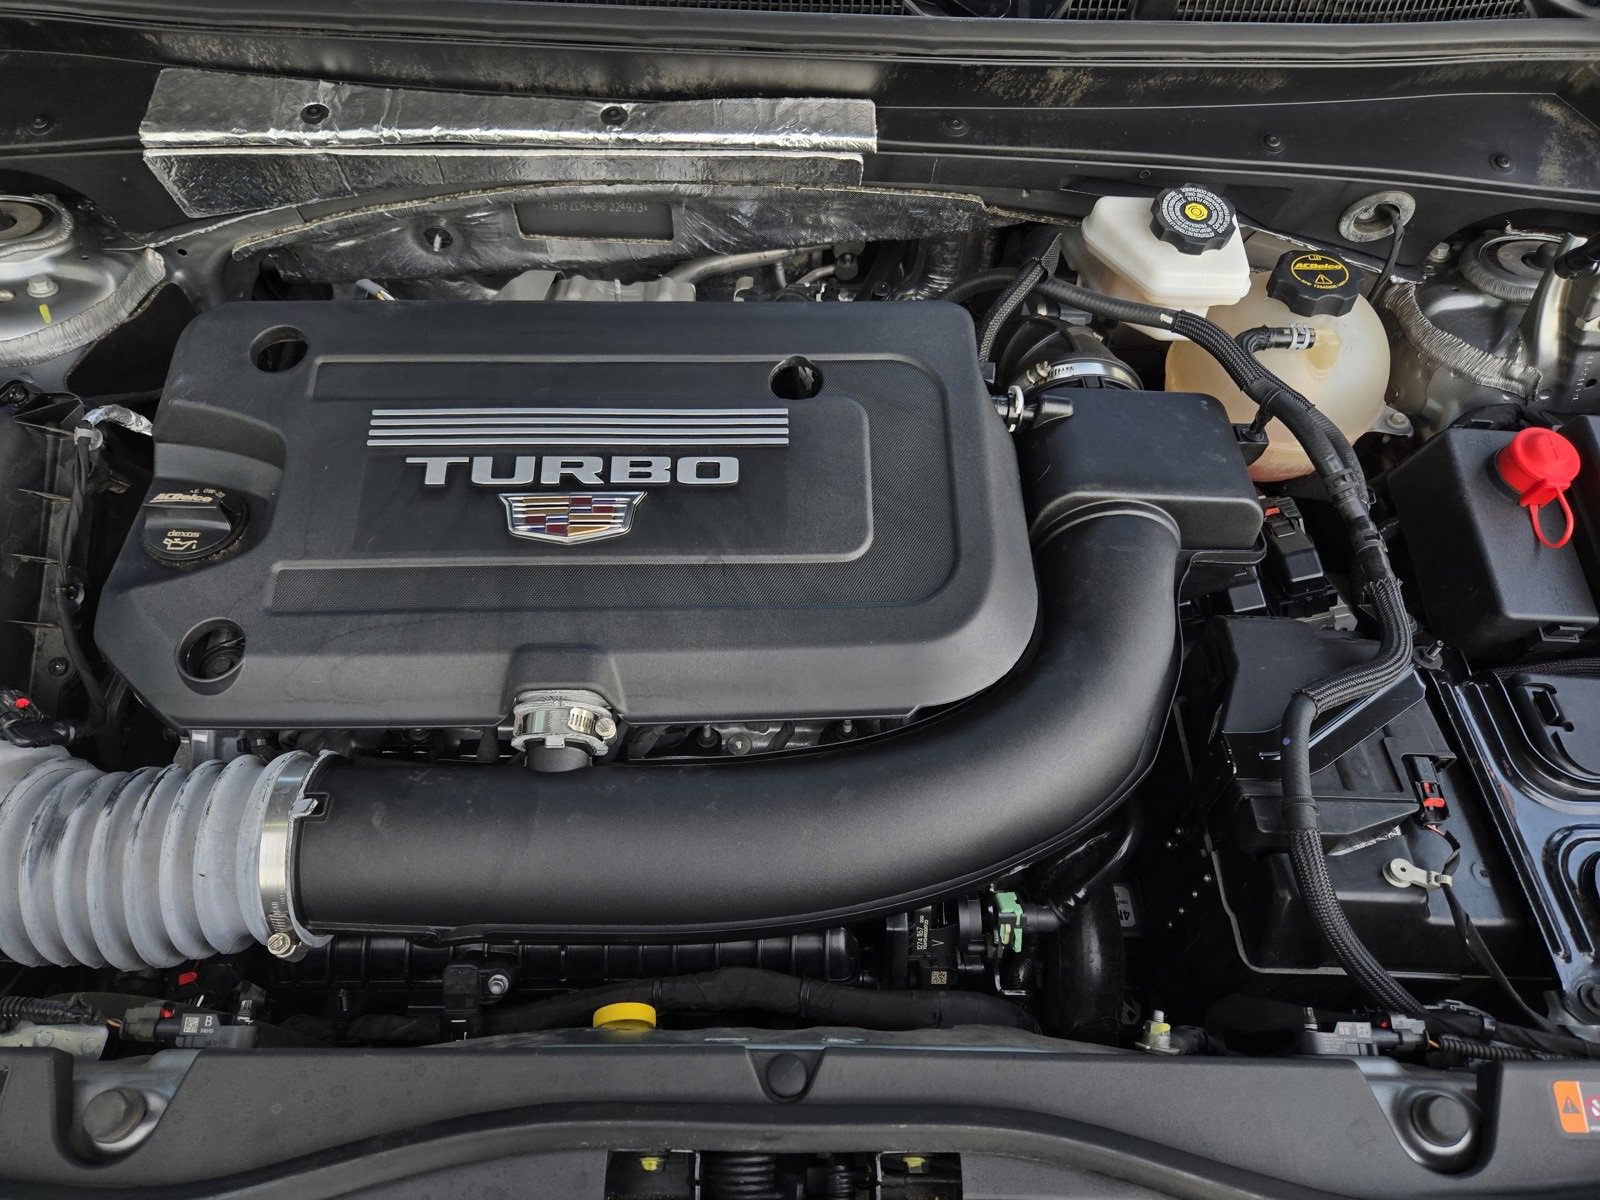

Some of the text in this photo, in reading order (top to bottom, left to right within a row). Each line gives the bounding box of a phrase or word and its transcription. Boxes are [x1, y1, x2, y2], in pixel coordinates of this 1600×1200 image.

[405, 456, 740, 485] TURBO
[149, 493, 213, 503] ACDelco
[167, 530, 201, 538] dexos
[204, 1015, 213, 1027] B
